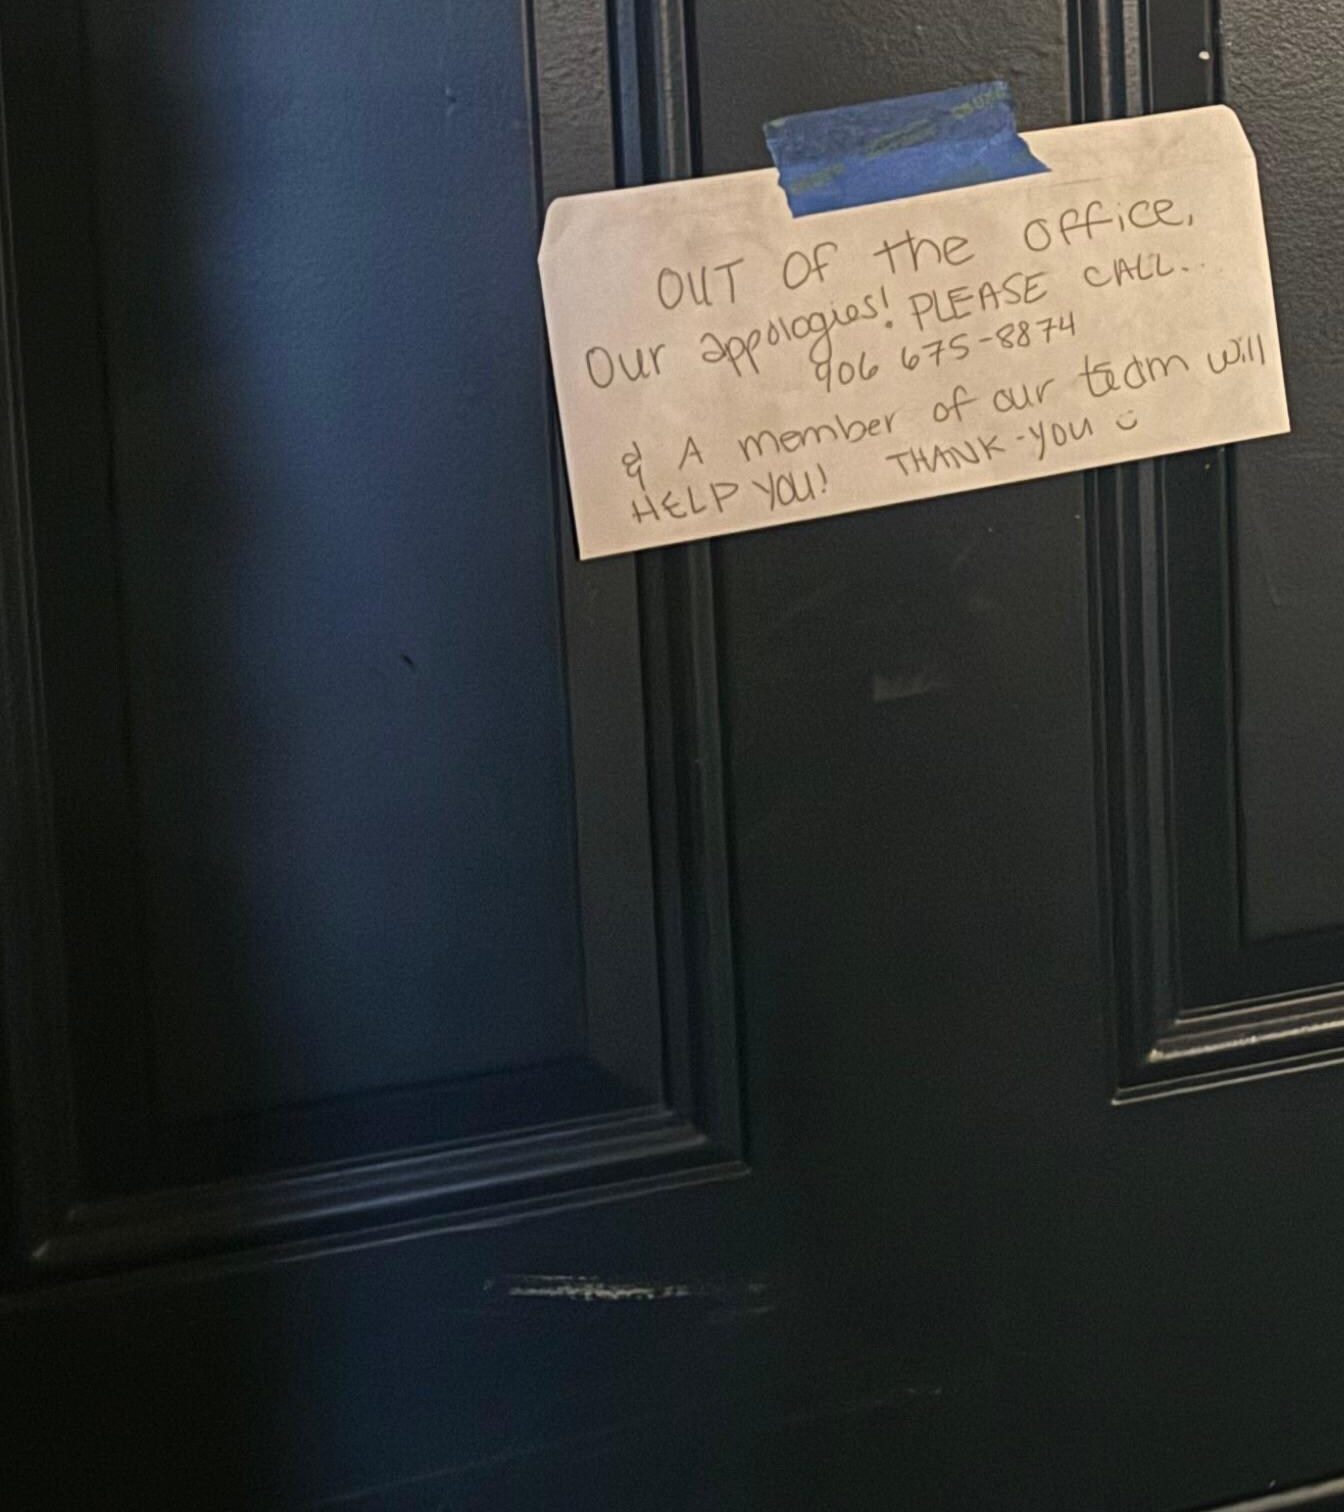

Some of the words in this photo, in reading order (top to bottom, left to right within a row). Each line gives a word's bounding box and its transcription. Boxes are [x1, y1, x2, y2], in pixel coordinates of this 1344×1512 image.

[658, 258, 744, 310] OUT
[873, 230, 974, 273] the
[586, 343, 665, 388] Our
[909, 272, 1048, 331] PLEASE
[815, 351, 879, 392] 906
[902, 312, 1075, 370] 675-8874
[679, 437, 703, 470] A
[738, 411, 896, 462] member
[933, 385, 976, 422] of
[994, 379, 1055, 413] our
[1079, 355, 1189, 397] team
[1207, 334, 1265, 374] will
[632, 482, 738, 523] HELP
